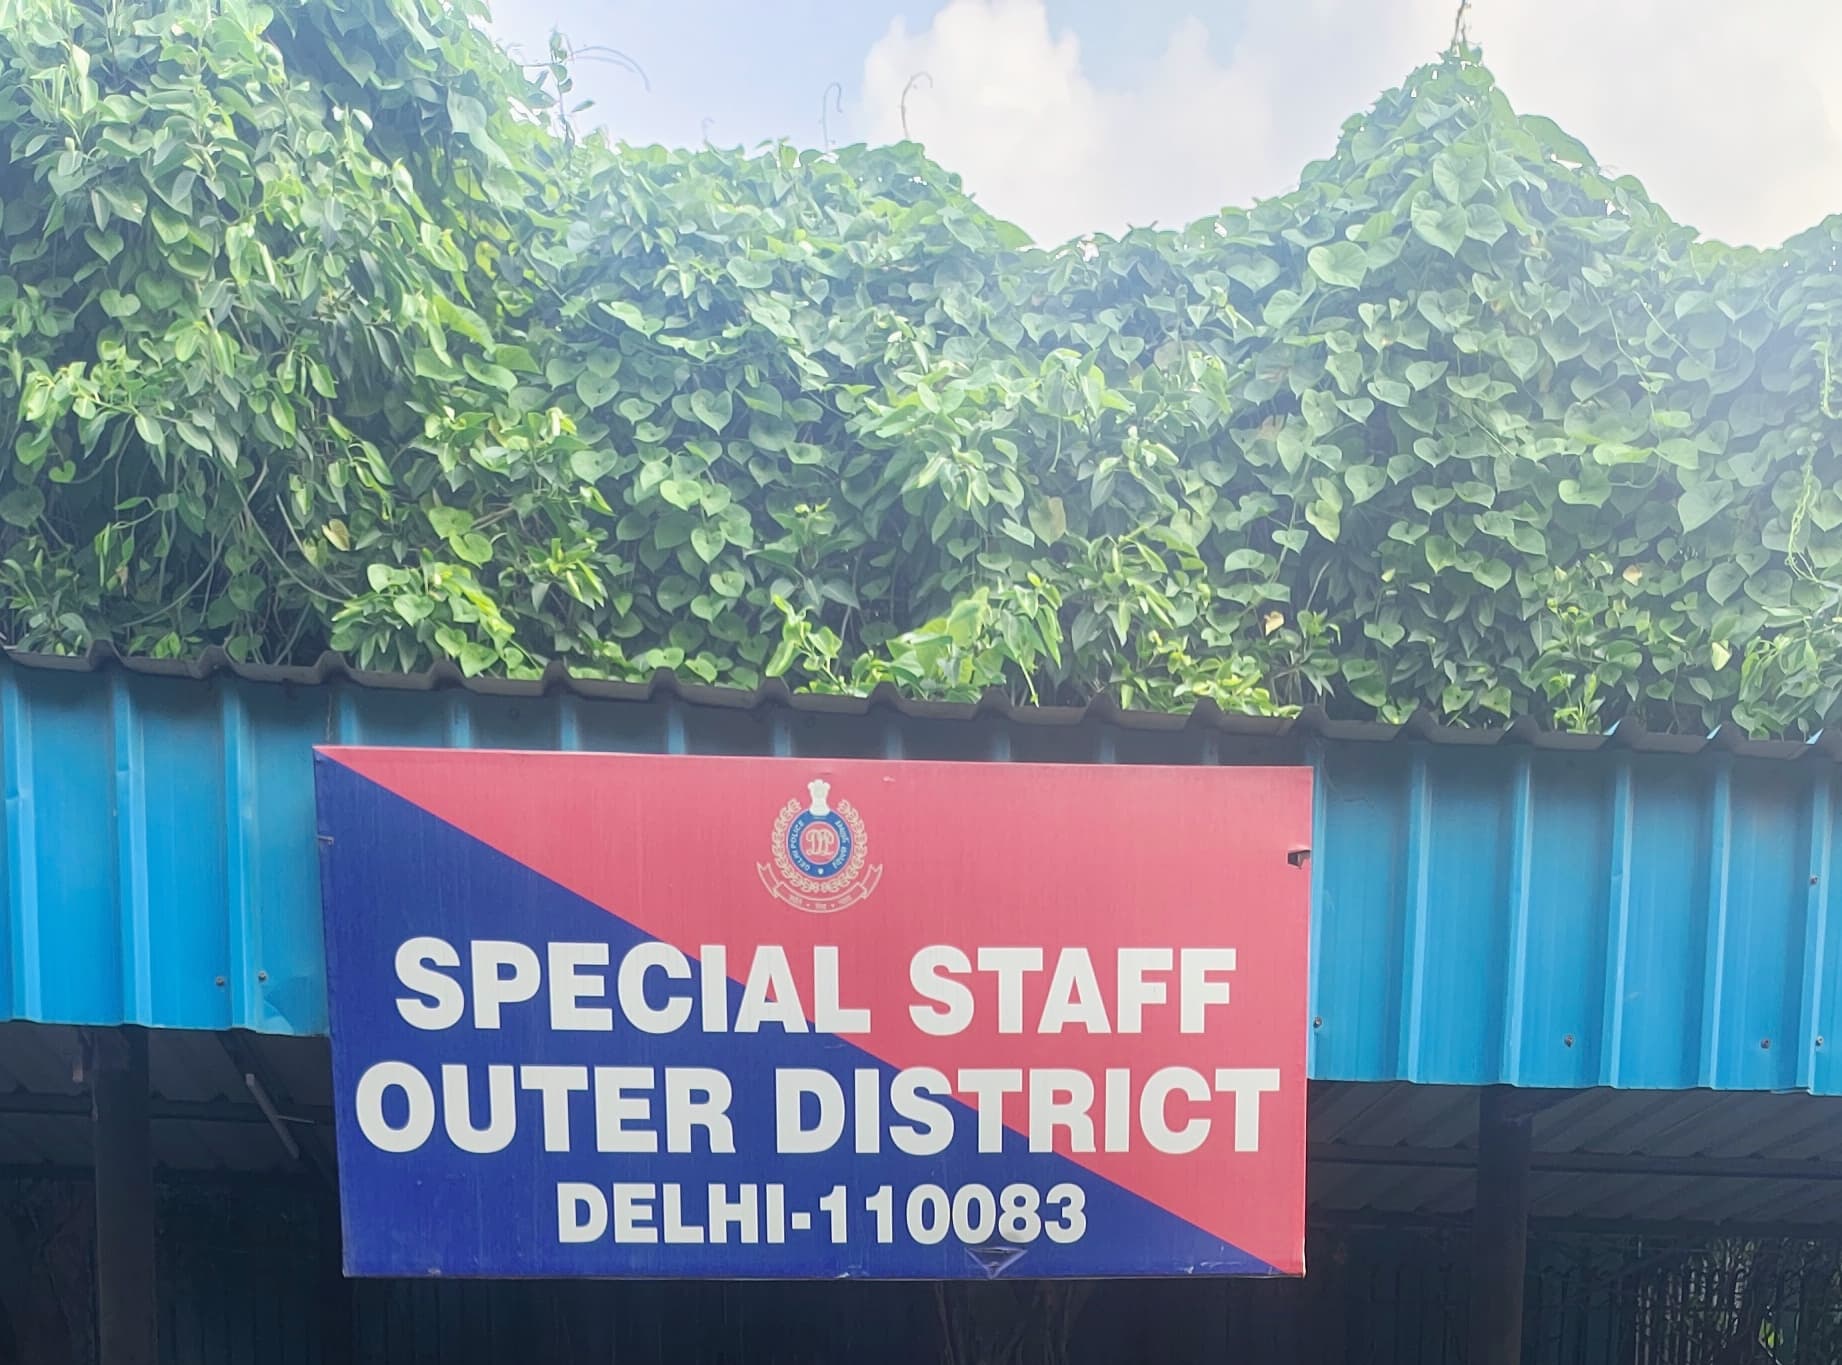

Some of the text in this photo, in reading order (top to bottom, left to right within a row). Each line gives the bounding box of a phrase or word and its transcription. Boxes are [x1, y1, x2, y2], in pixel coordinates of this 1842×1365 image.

[791, 820, 804, 849] POLICE
[396, 936, 1237, 1035] SPECIAL STAFF
[356, 1061, 1280, 1155] OUTER DISTRICT
[557, 1183, 1087, 1245] DELHI-110083
